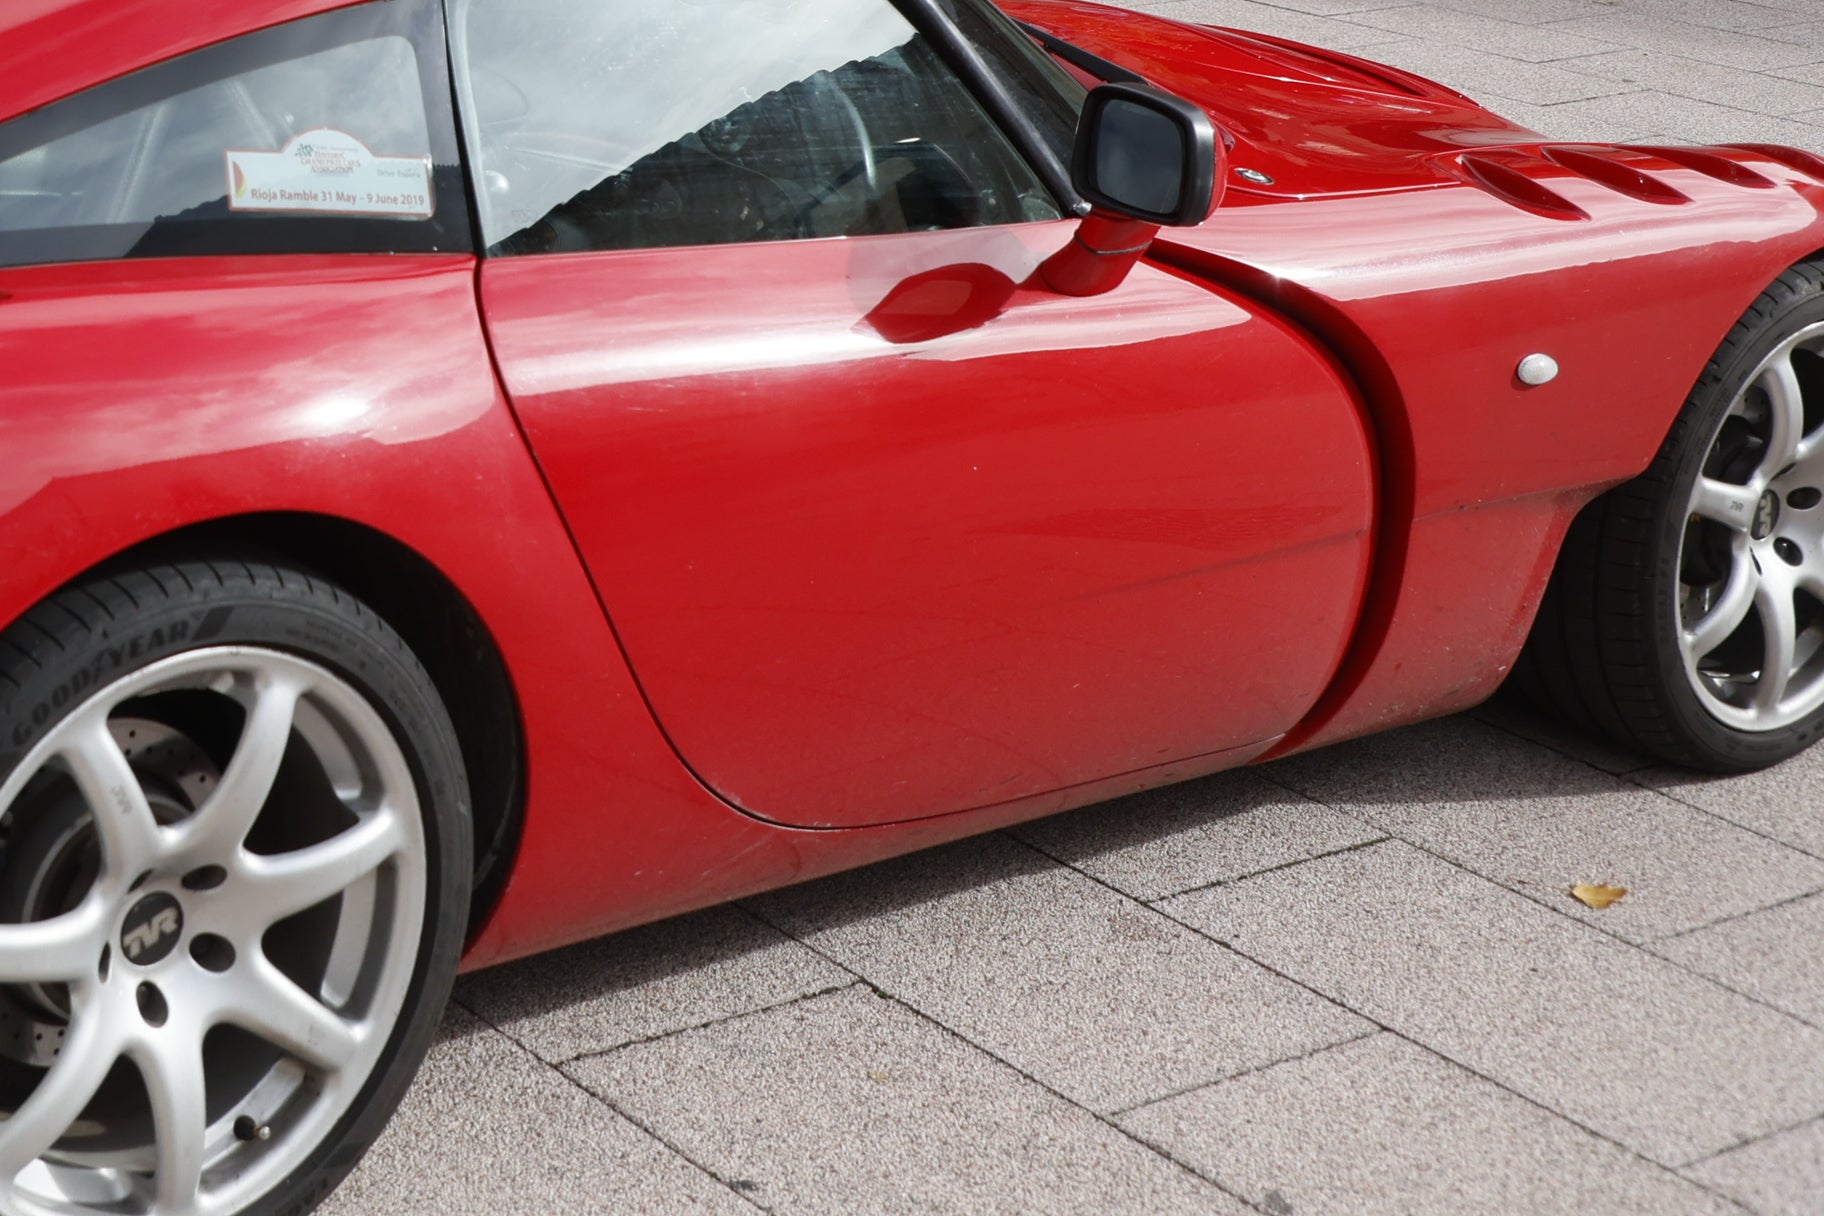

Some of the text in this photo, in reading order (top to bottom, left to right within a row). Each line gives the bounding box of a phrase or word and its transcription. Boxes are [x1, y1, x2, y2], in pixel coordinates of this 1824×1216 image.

[251, 188, 278, 203] Rioja
[280, 189, 319, 202] Ramble
[321, 190, 333, 202] 31
[336, 191, 357, 205] May
[367, 193, 373, 203] 9
[375, 194, 398, 205] June
[401, 194, 425, 205] 2019
[122, 905, 180, 960] TVR
